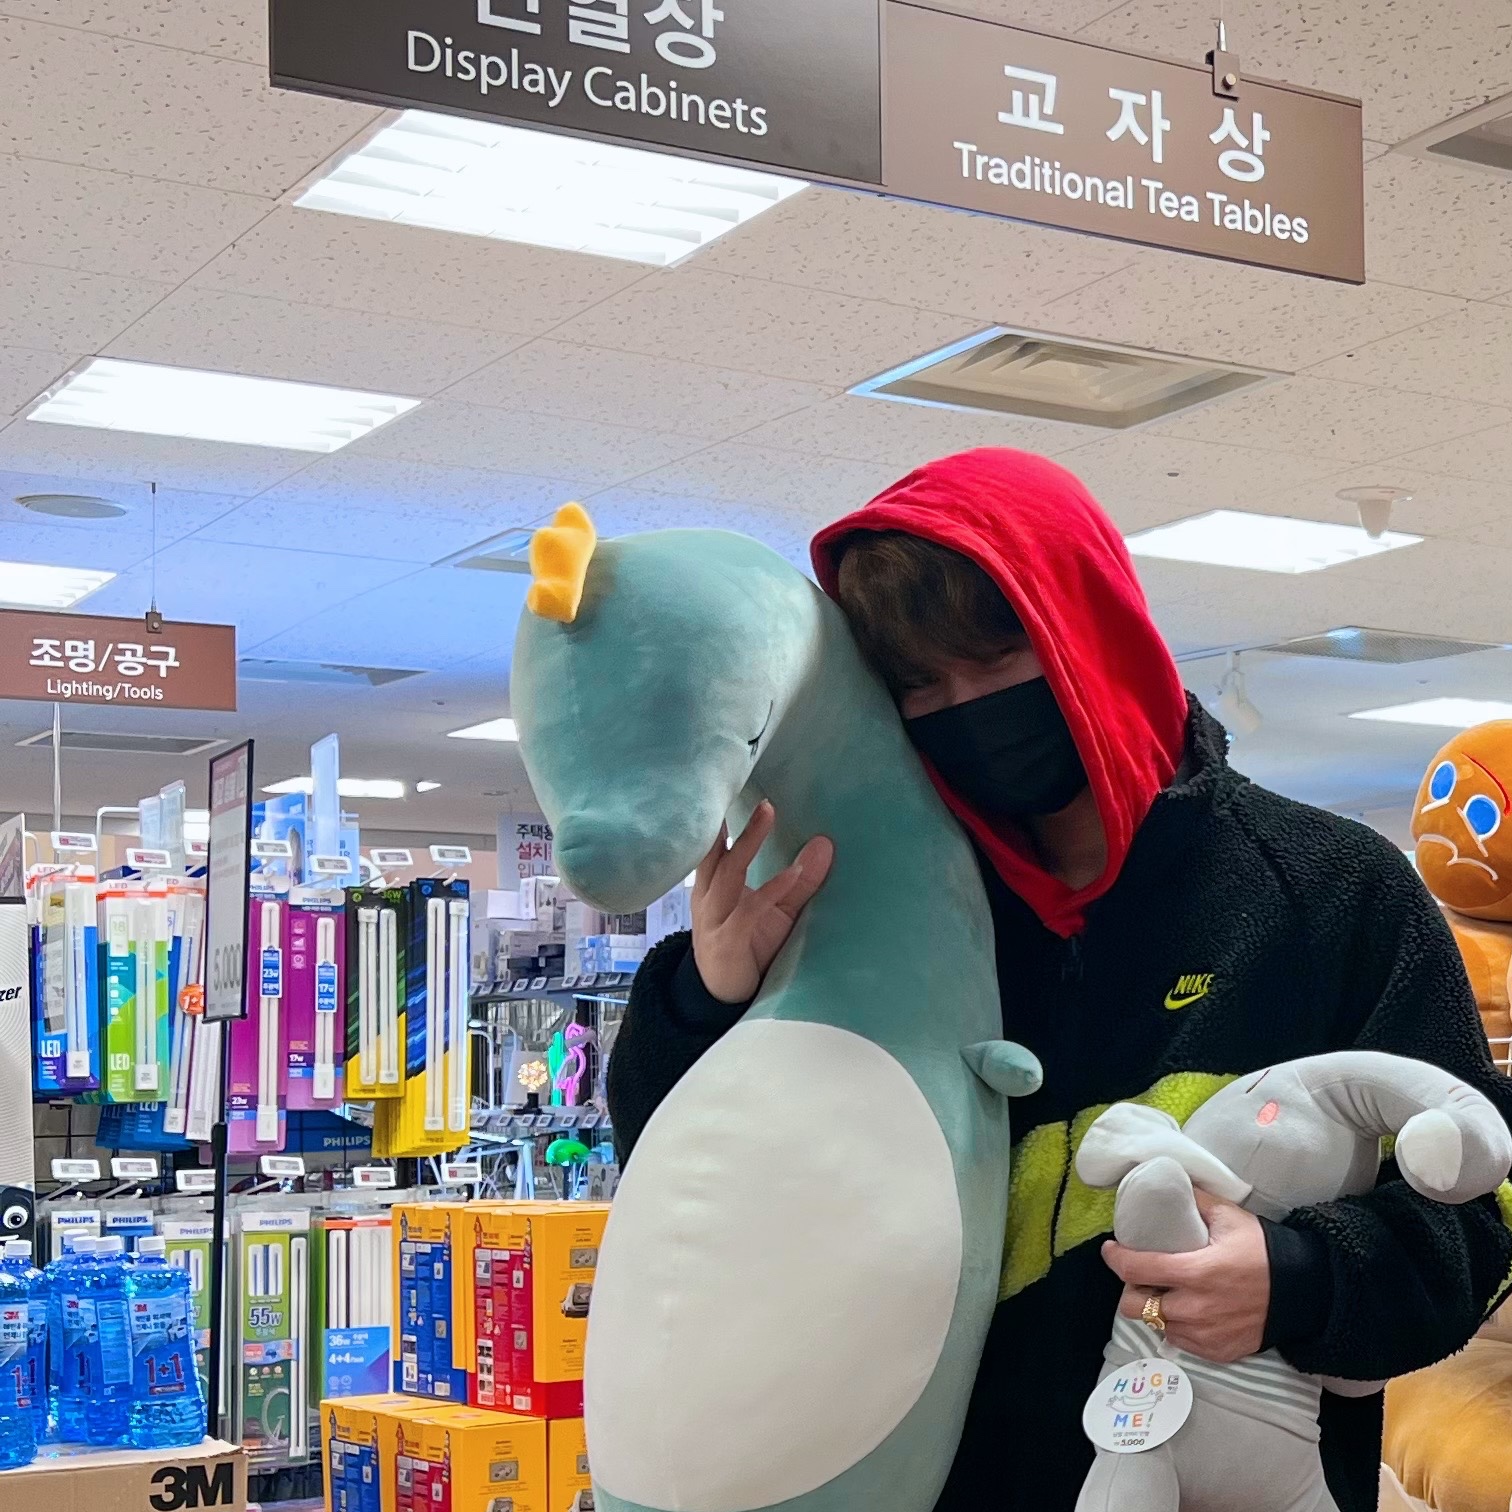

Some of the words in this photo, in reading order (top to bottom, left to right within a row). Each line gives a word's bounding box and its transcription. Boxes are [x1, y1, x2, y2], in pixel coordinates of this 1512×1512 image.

[406, 29, 572, 108] Display
[583, 66, 769, 137] Cabinets
[952, 141, 1134, 209] Traditional
[1141, 179, 1199, 222] Tea
[1205, 191, 1309, 244] Tables
[28, 638, 181, 678] 조명/공구
[46, 678, 164, 701] Lighting/Tools
[516, 841, 553, 861] 설치
[1173, 973, 1215, 995] NIKE
[41, 1039, 61, 1058] LED
[110, 1053, 130, 1070] LED
[323, 1134, 371, 1149] PHILIPS
[57, 1215, 95, 1224] PHILIPS
[112, 1215, 148, 1224] PHILIPS
[259, 1218, 293, 1227] PHILIPS
[134, 1303, 148, 1313] 3M
[144, 1352, 185, 1385] 1+1
[149, 1461, 234, 1512] 3M
